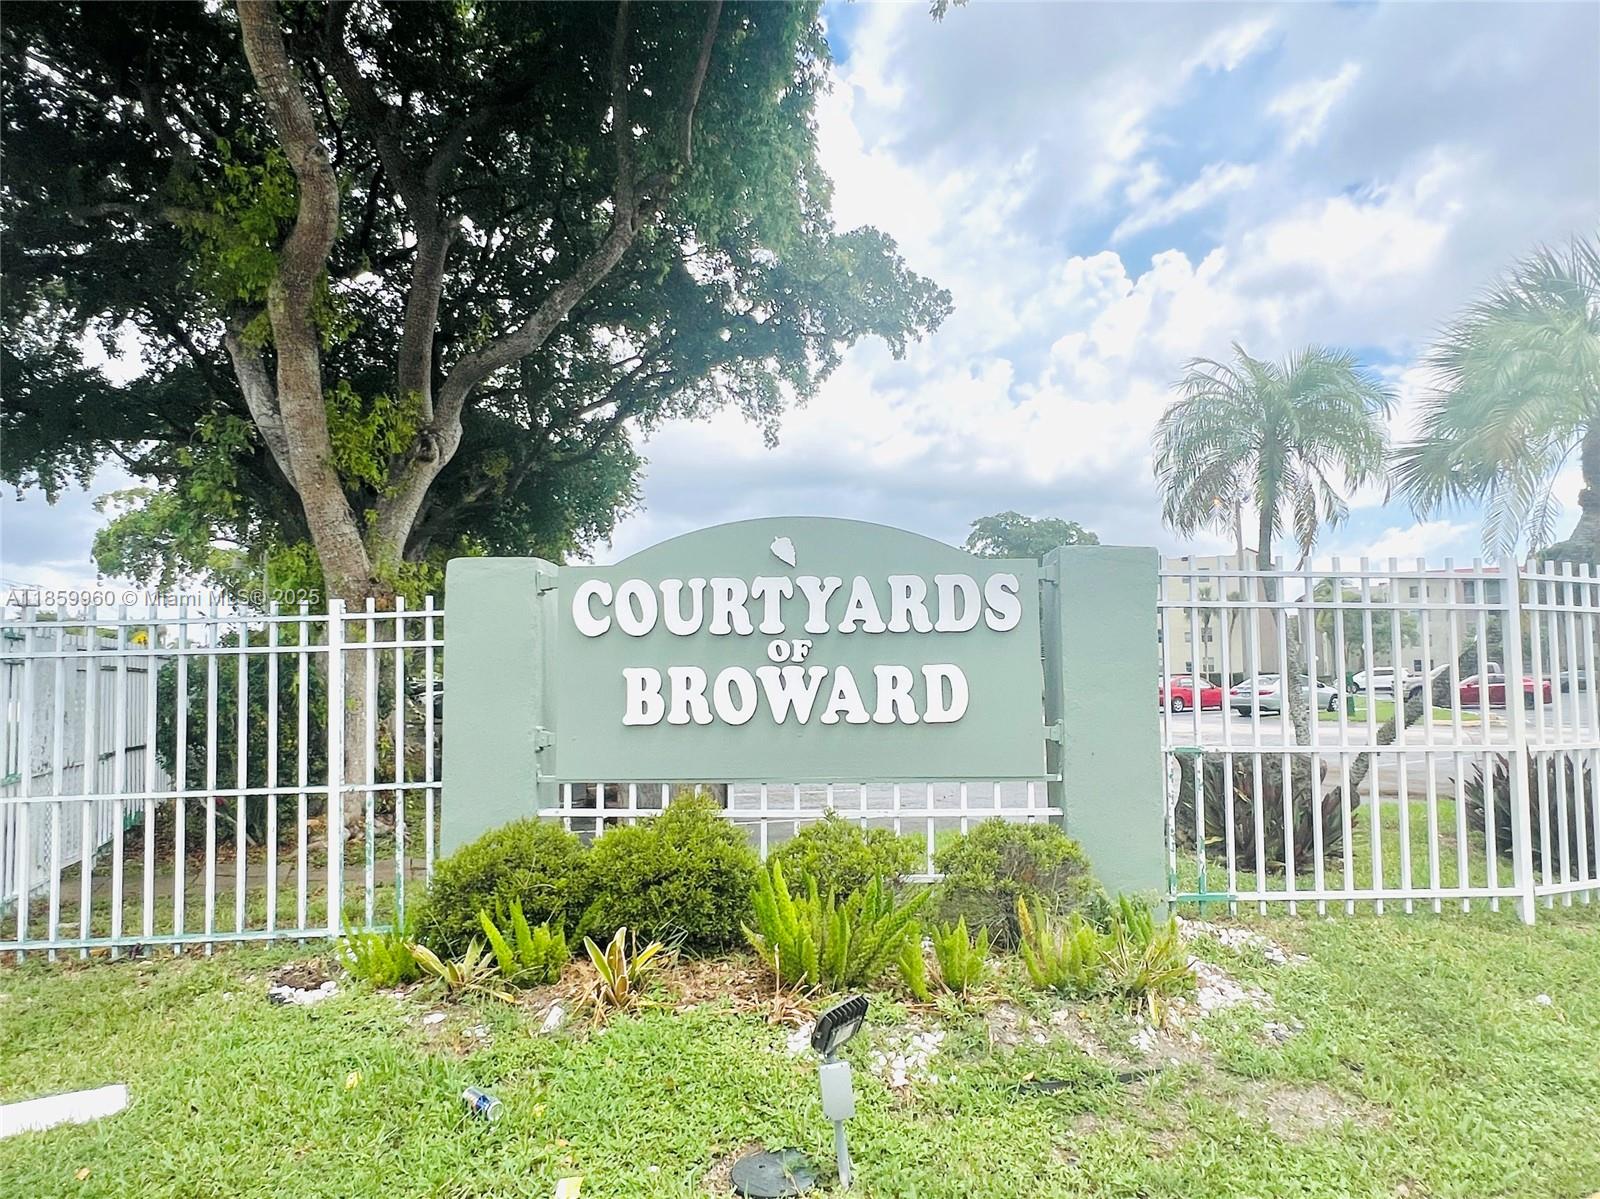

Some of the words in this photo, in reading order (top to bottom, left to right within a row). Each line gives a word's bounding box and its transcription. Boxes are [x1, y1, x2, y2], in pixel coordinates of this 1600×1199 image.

[572, 573, 1022, 637] COURTYARDS
[767, 639, 812, 662] OF
[622, 664, 969, 726] BROWARD
